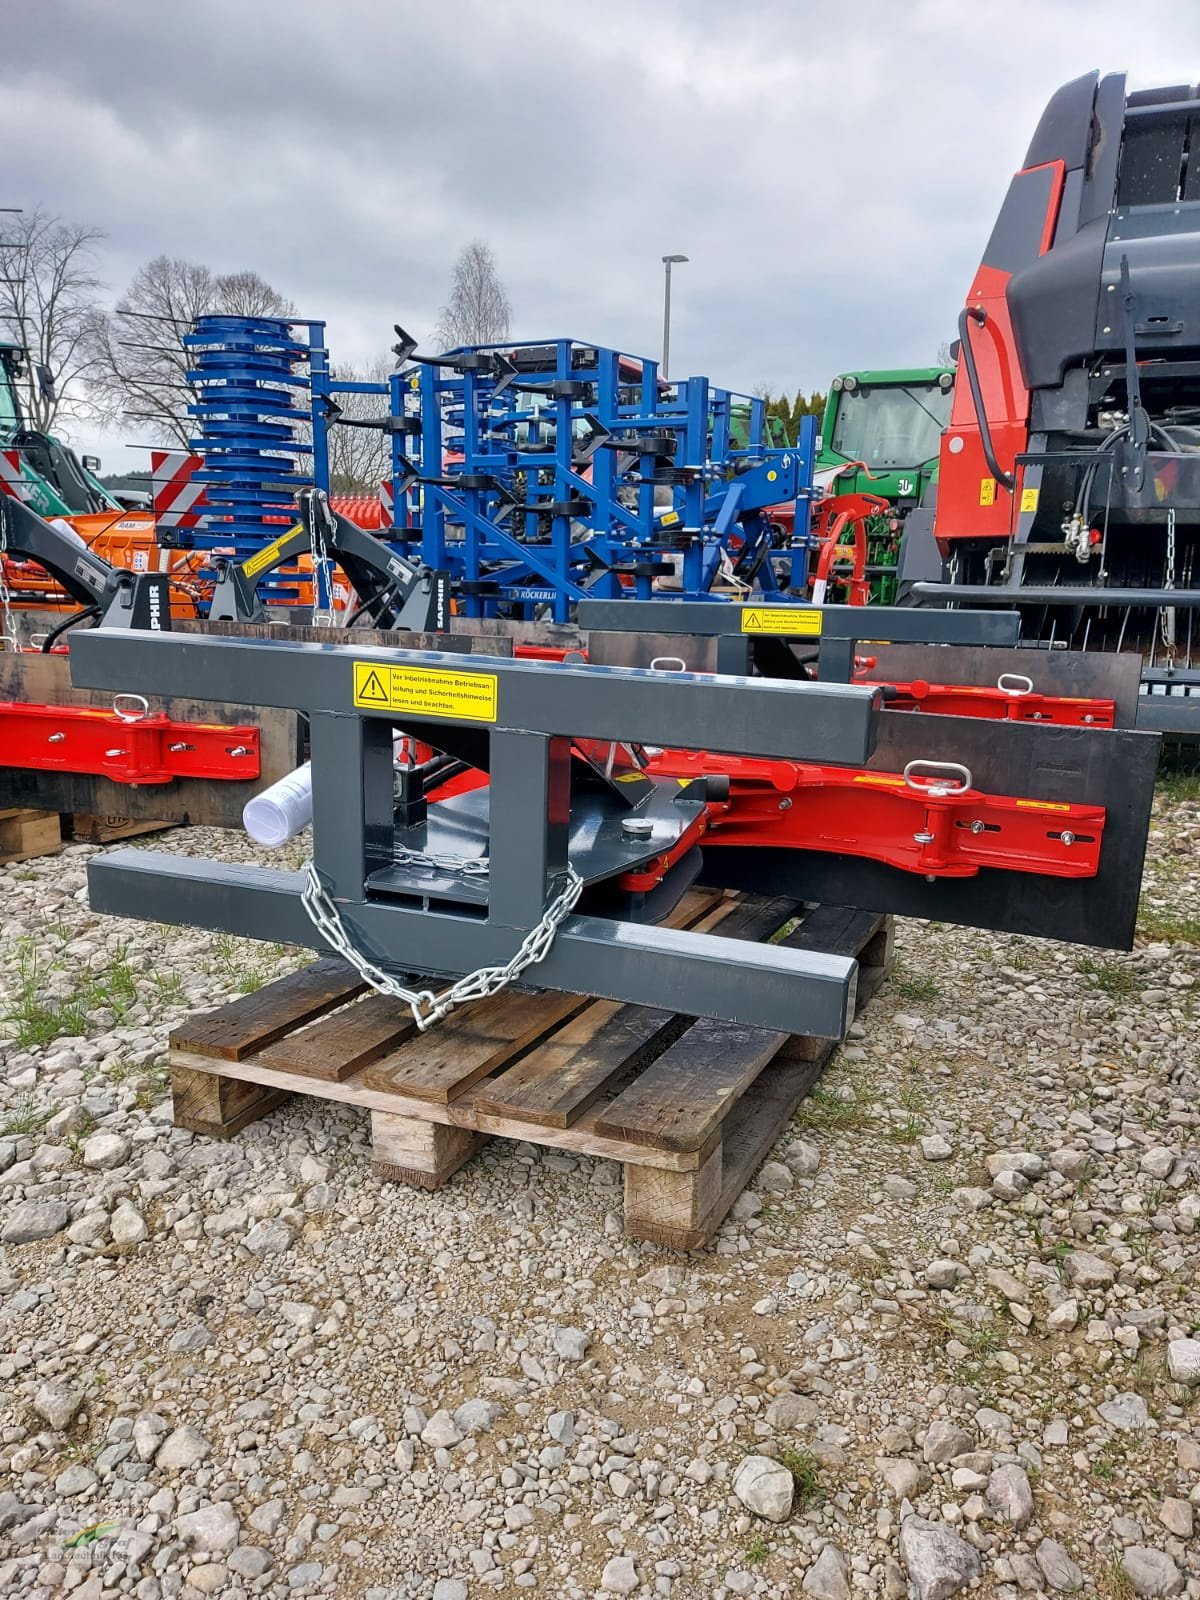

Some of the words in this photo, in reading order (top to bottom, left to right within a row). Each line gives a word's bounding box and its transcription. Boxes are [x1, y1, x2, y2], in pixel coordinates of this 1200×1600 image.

[149, 585, 160, 631] PHIR
[392, 673, 403, 681] Vor
[404, 674, 453, 686] Inbetriebnahme
[392, 685, 414, 695] leitung
[429, 689, 492, 702] Sicherheitshinweise
[392, 697, 409, 705] lesen
